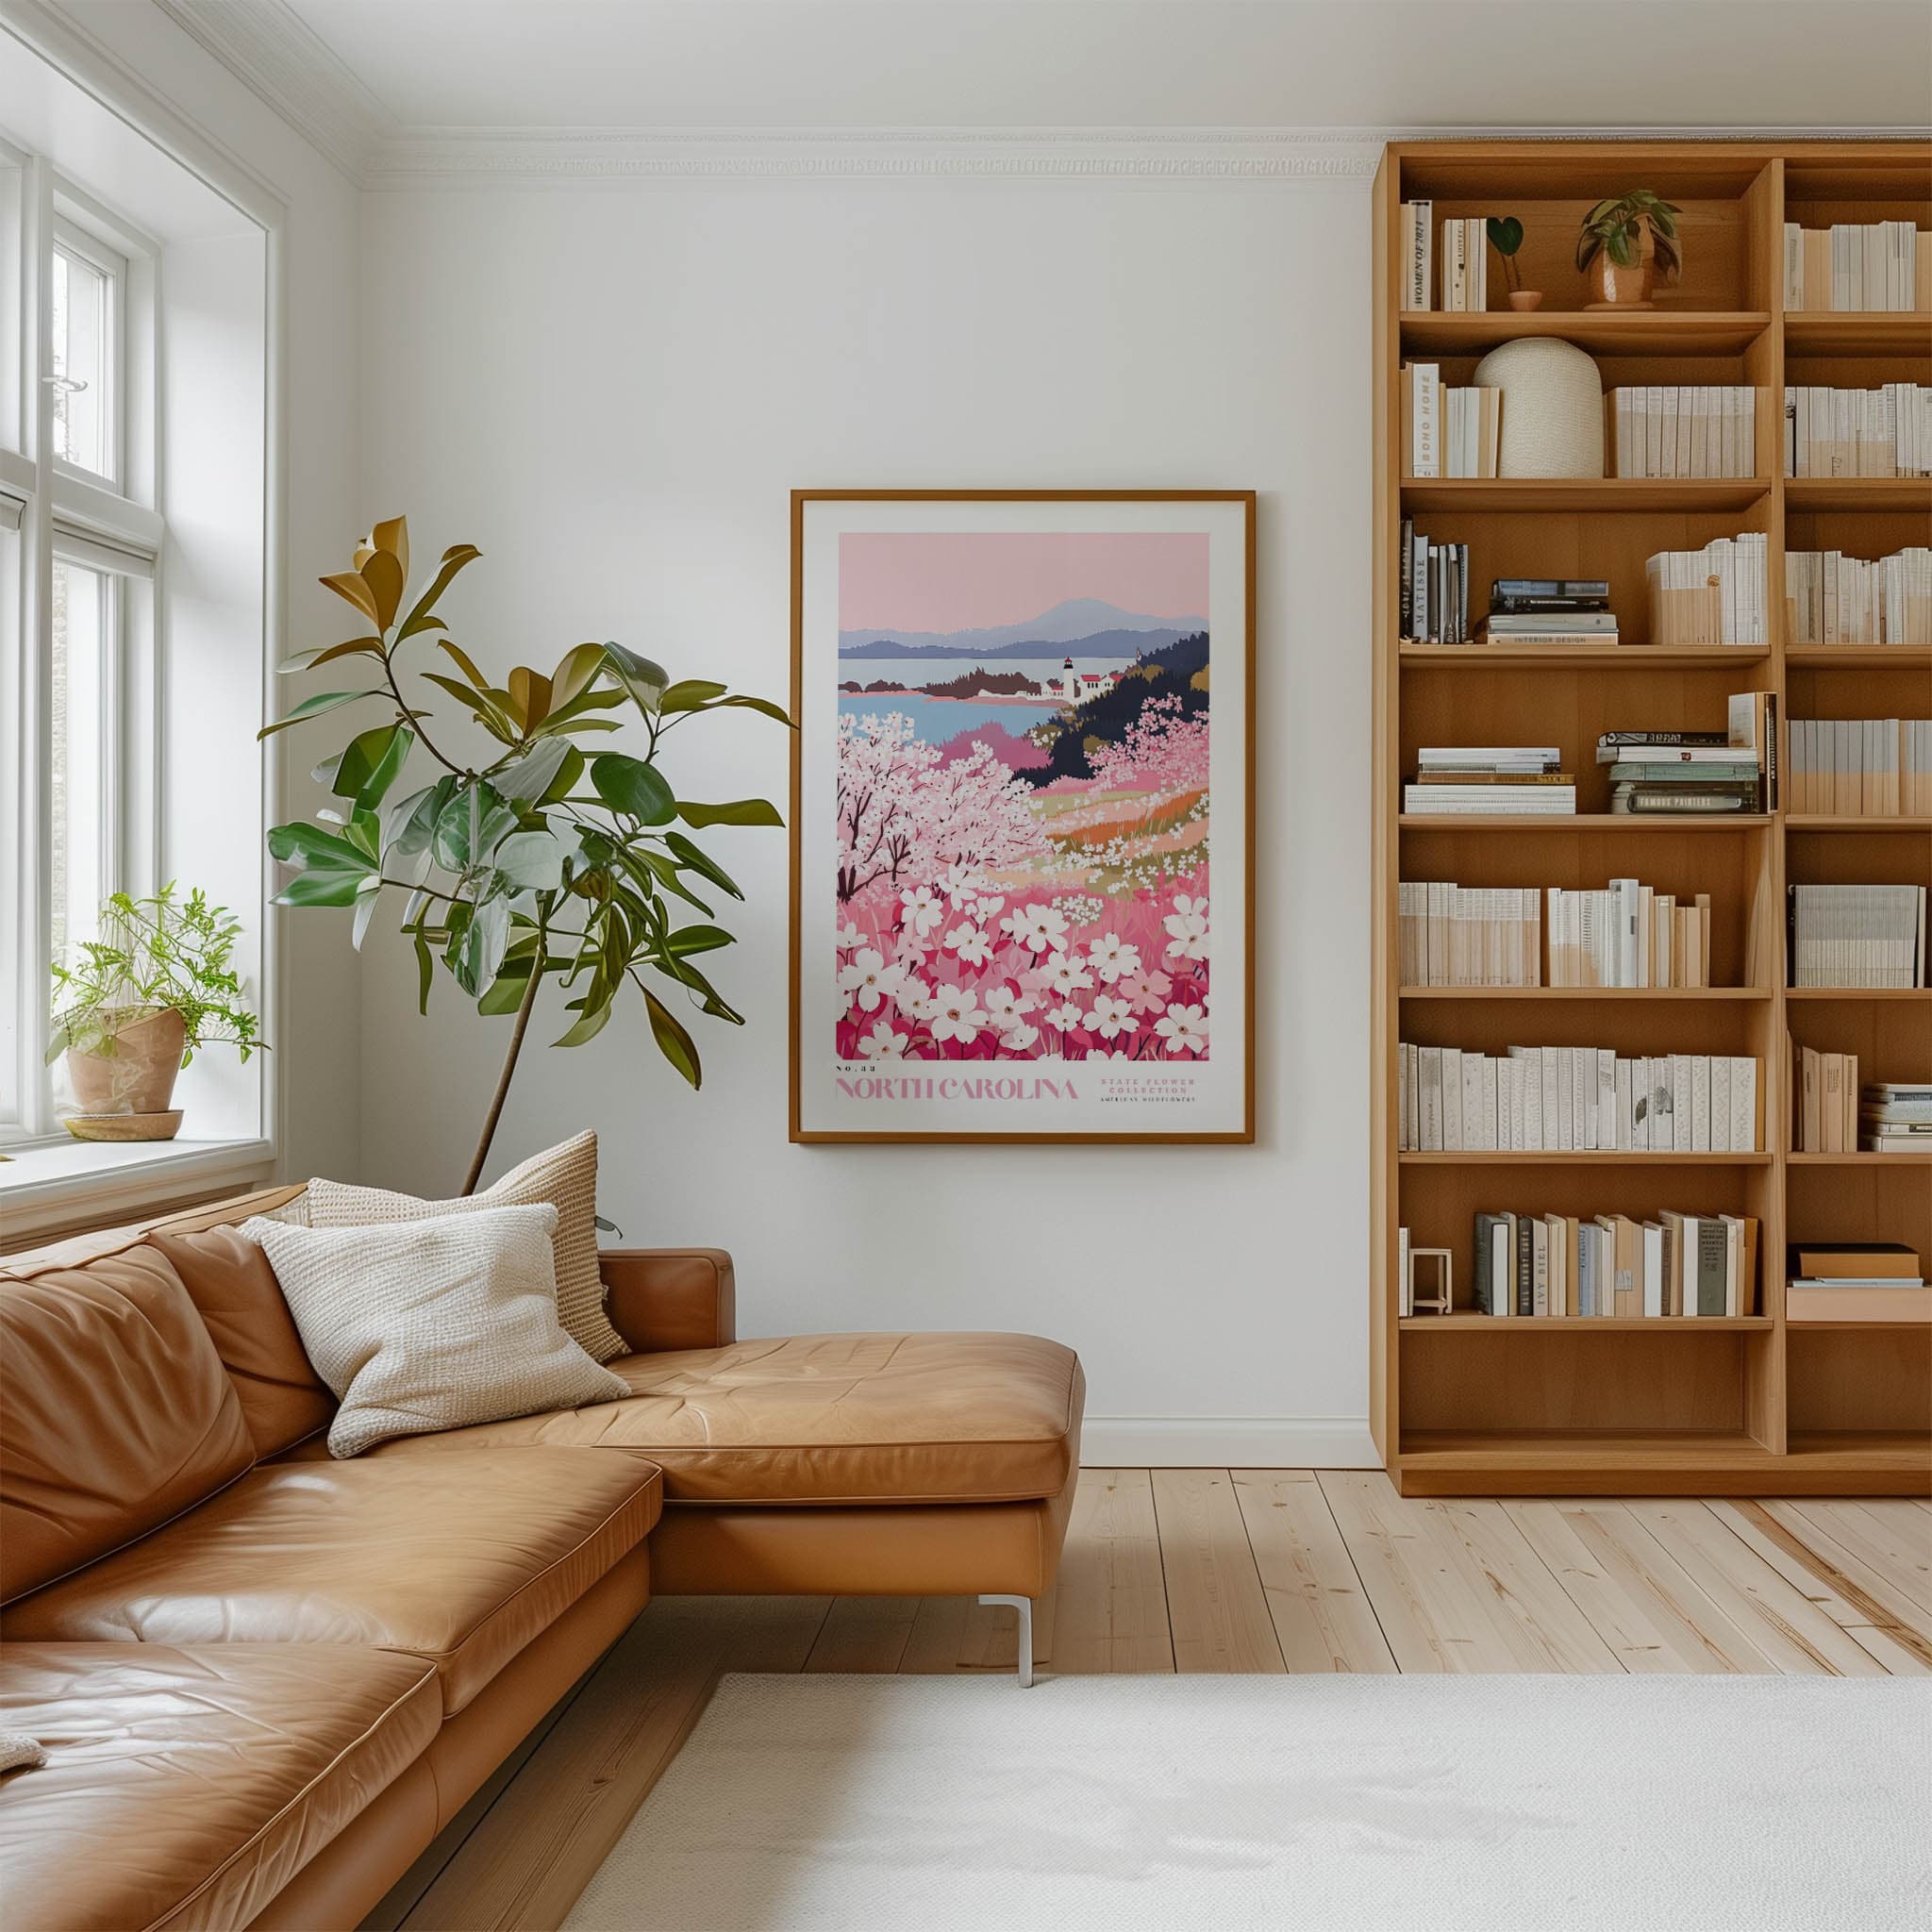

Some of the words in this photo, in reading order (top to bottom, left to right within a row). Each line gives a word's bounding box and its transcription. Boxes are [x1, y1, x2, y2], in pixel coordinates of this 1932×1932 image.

[1415, 244, 1424, 260] OF
[1414, 261, 1424, 305] WOMEN
[1422, 375, 1431, 415] HOME
[1422, 422, 1431, 462] BOHO
[1416, 559, 1425, 625] MATISSE
[1640, 797, 1672, 807] FAMOUS
[1674, 797, 1711, 807] PAINTERS
[836, 1078, 934, 1099] NORTH
[939, 1077, 1079, 1100] CAROLINA
[1537, 1245, 1546, 1274] BIEL
[1537, 1282, 1546, 1306] IVY
